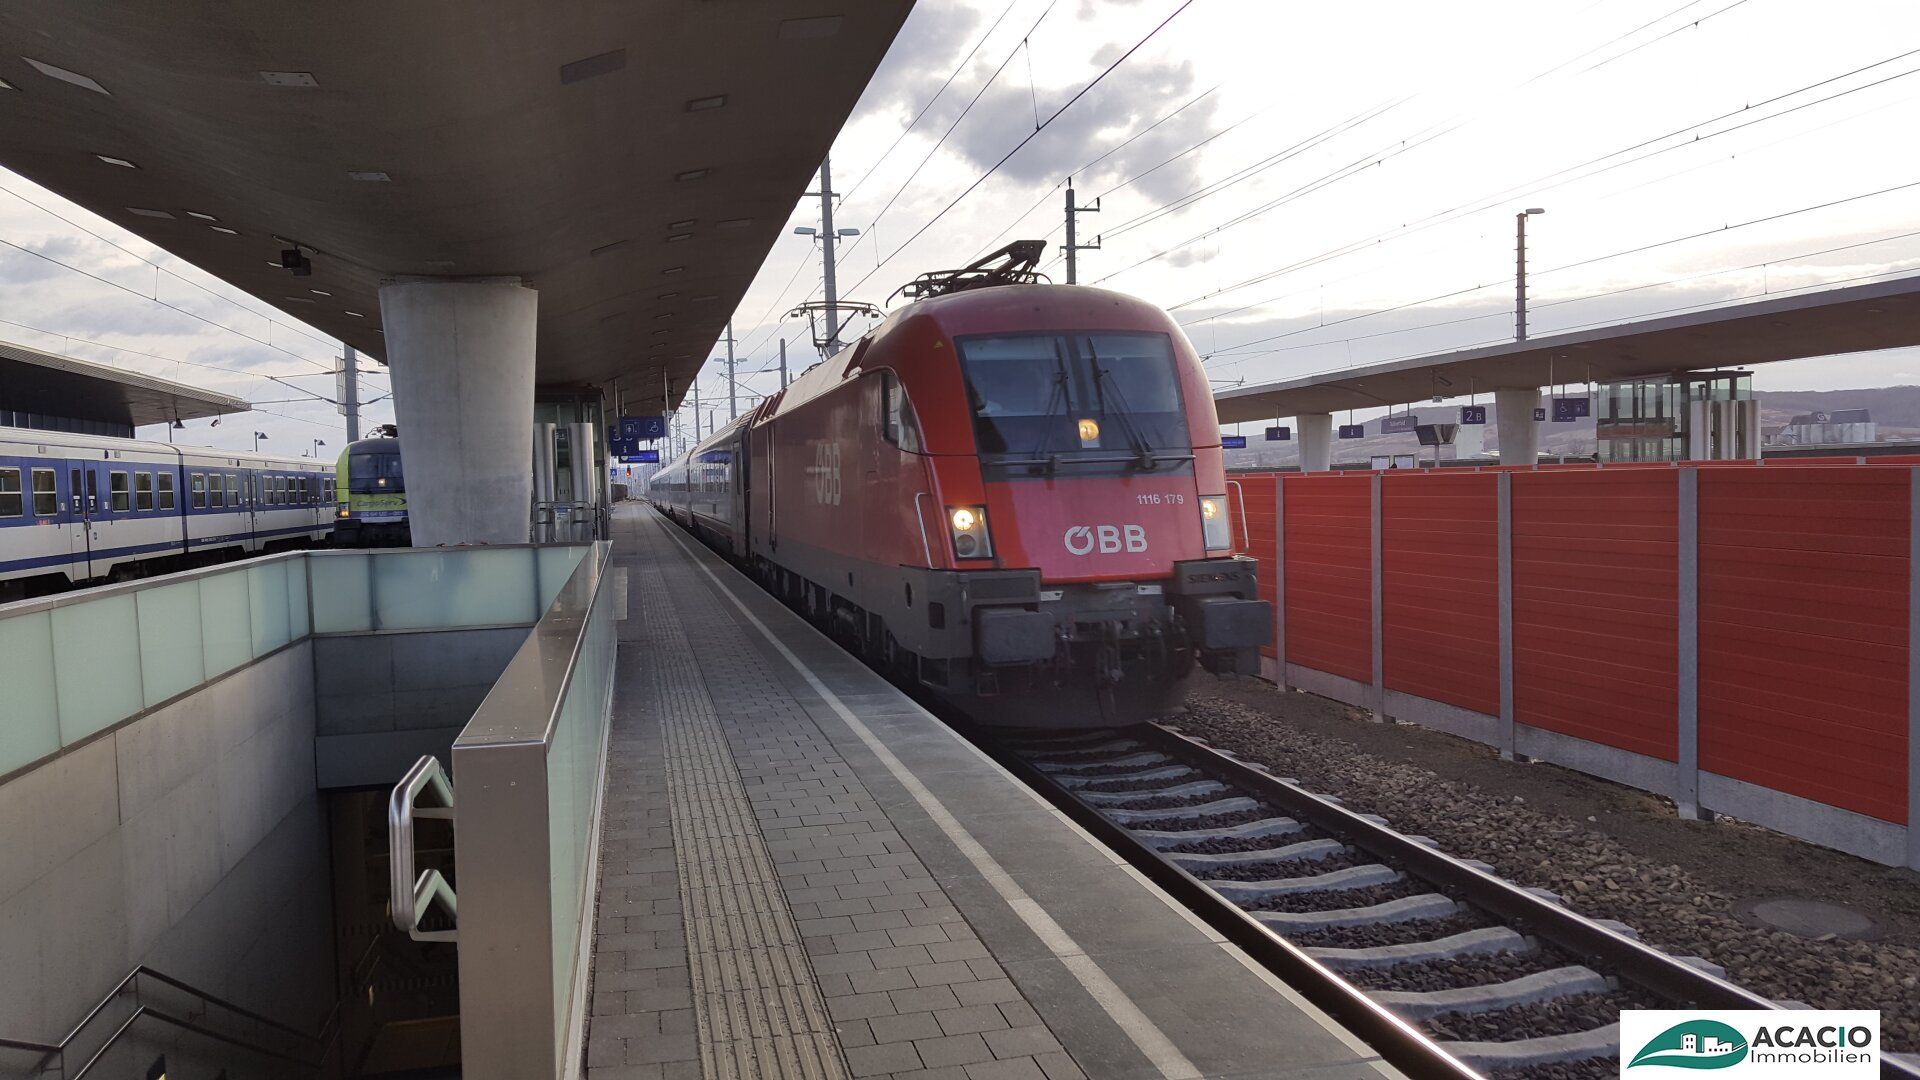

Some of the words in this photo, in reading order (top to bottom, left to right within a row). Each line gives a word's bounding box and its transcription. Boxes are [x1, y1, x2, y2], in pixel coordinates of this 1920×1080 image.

[1466, 410, 1473, 422] 2
[1476, 412, 1482, 422] B
[1136, 494, 1160, 505] 1116
[1164, 494, 1184, 505] 179
[1064, 524, 1148, 556] ÖBB
